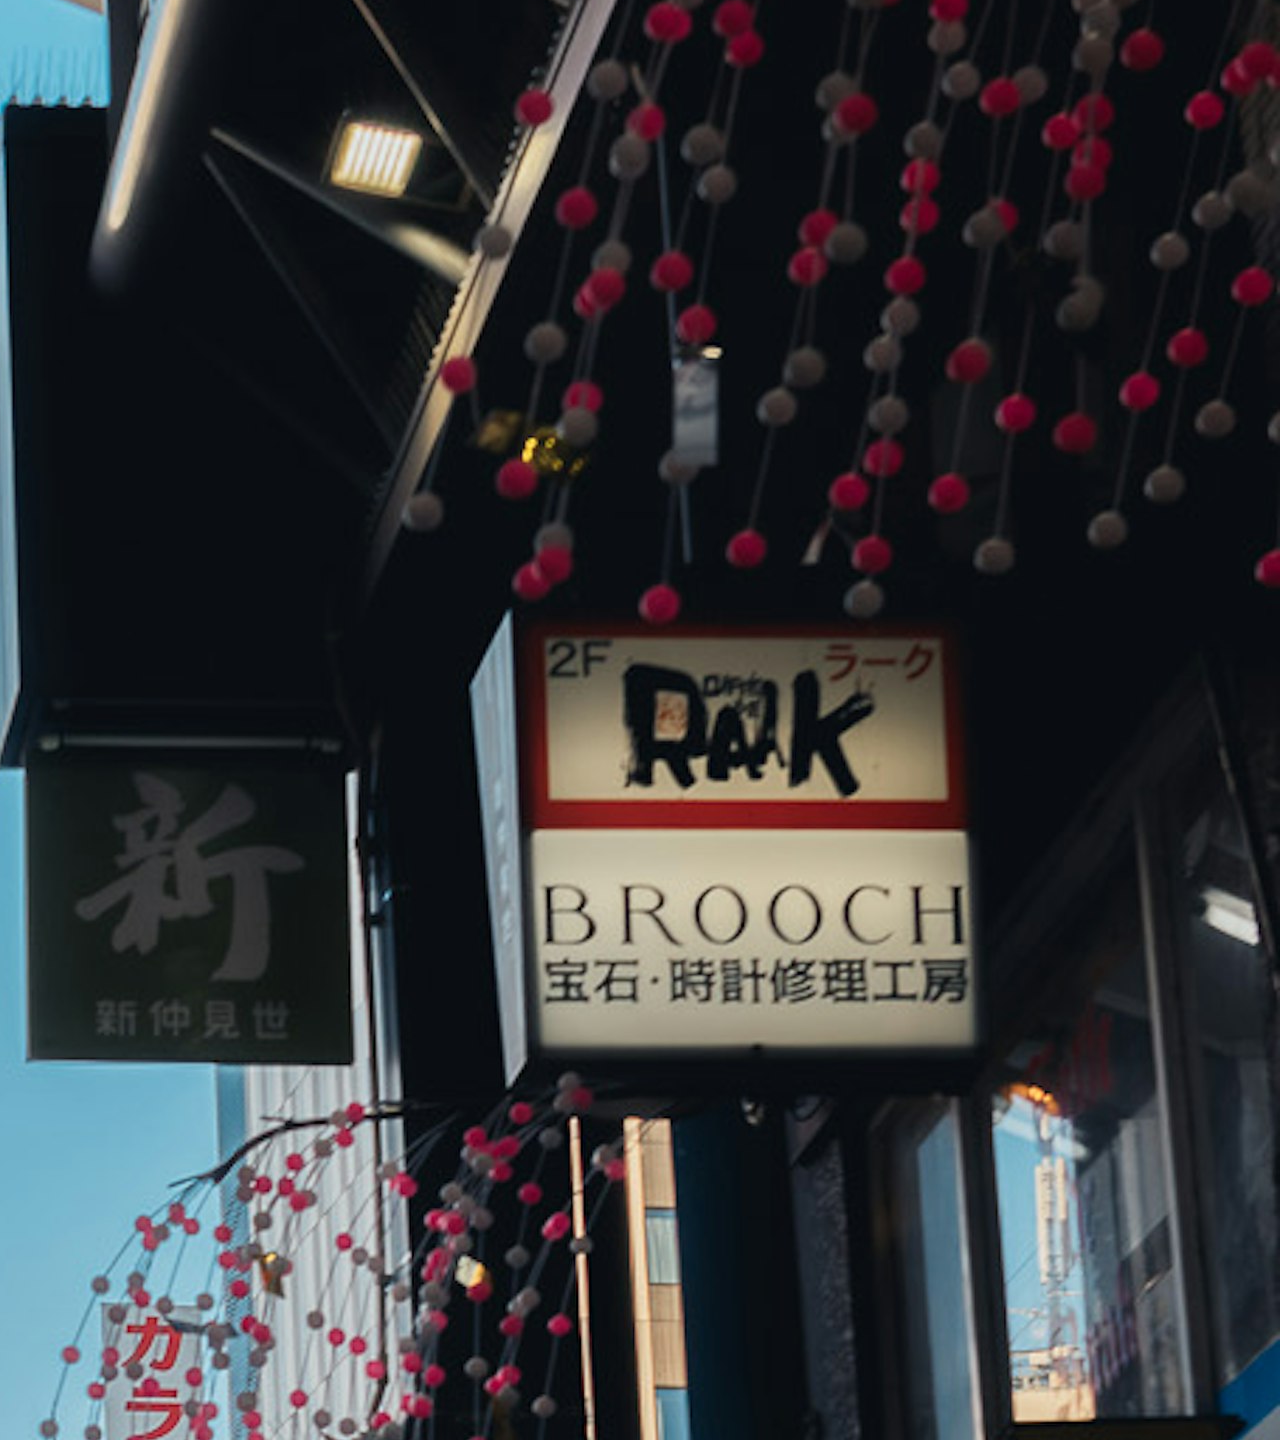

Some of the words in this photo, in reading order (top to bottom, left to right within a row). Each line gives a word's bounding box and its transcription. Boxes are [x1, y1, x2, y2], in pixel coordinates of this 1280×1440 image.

[548, 639, 613, 679] 2F
[825, 641, 935, 682] ラーク
[74, 770, 306, 983] 新
[542, 885, 966, 947] BROOCH
[544, 958, 969, 1005] 宝石・時計修理工房
[95, 999, 289, 1040] 新仲見世
